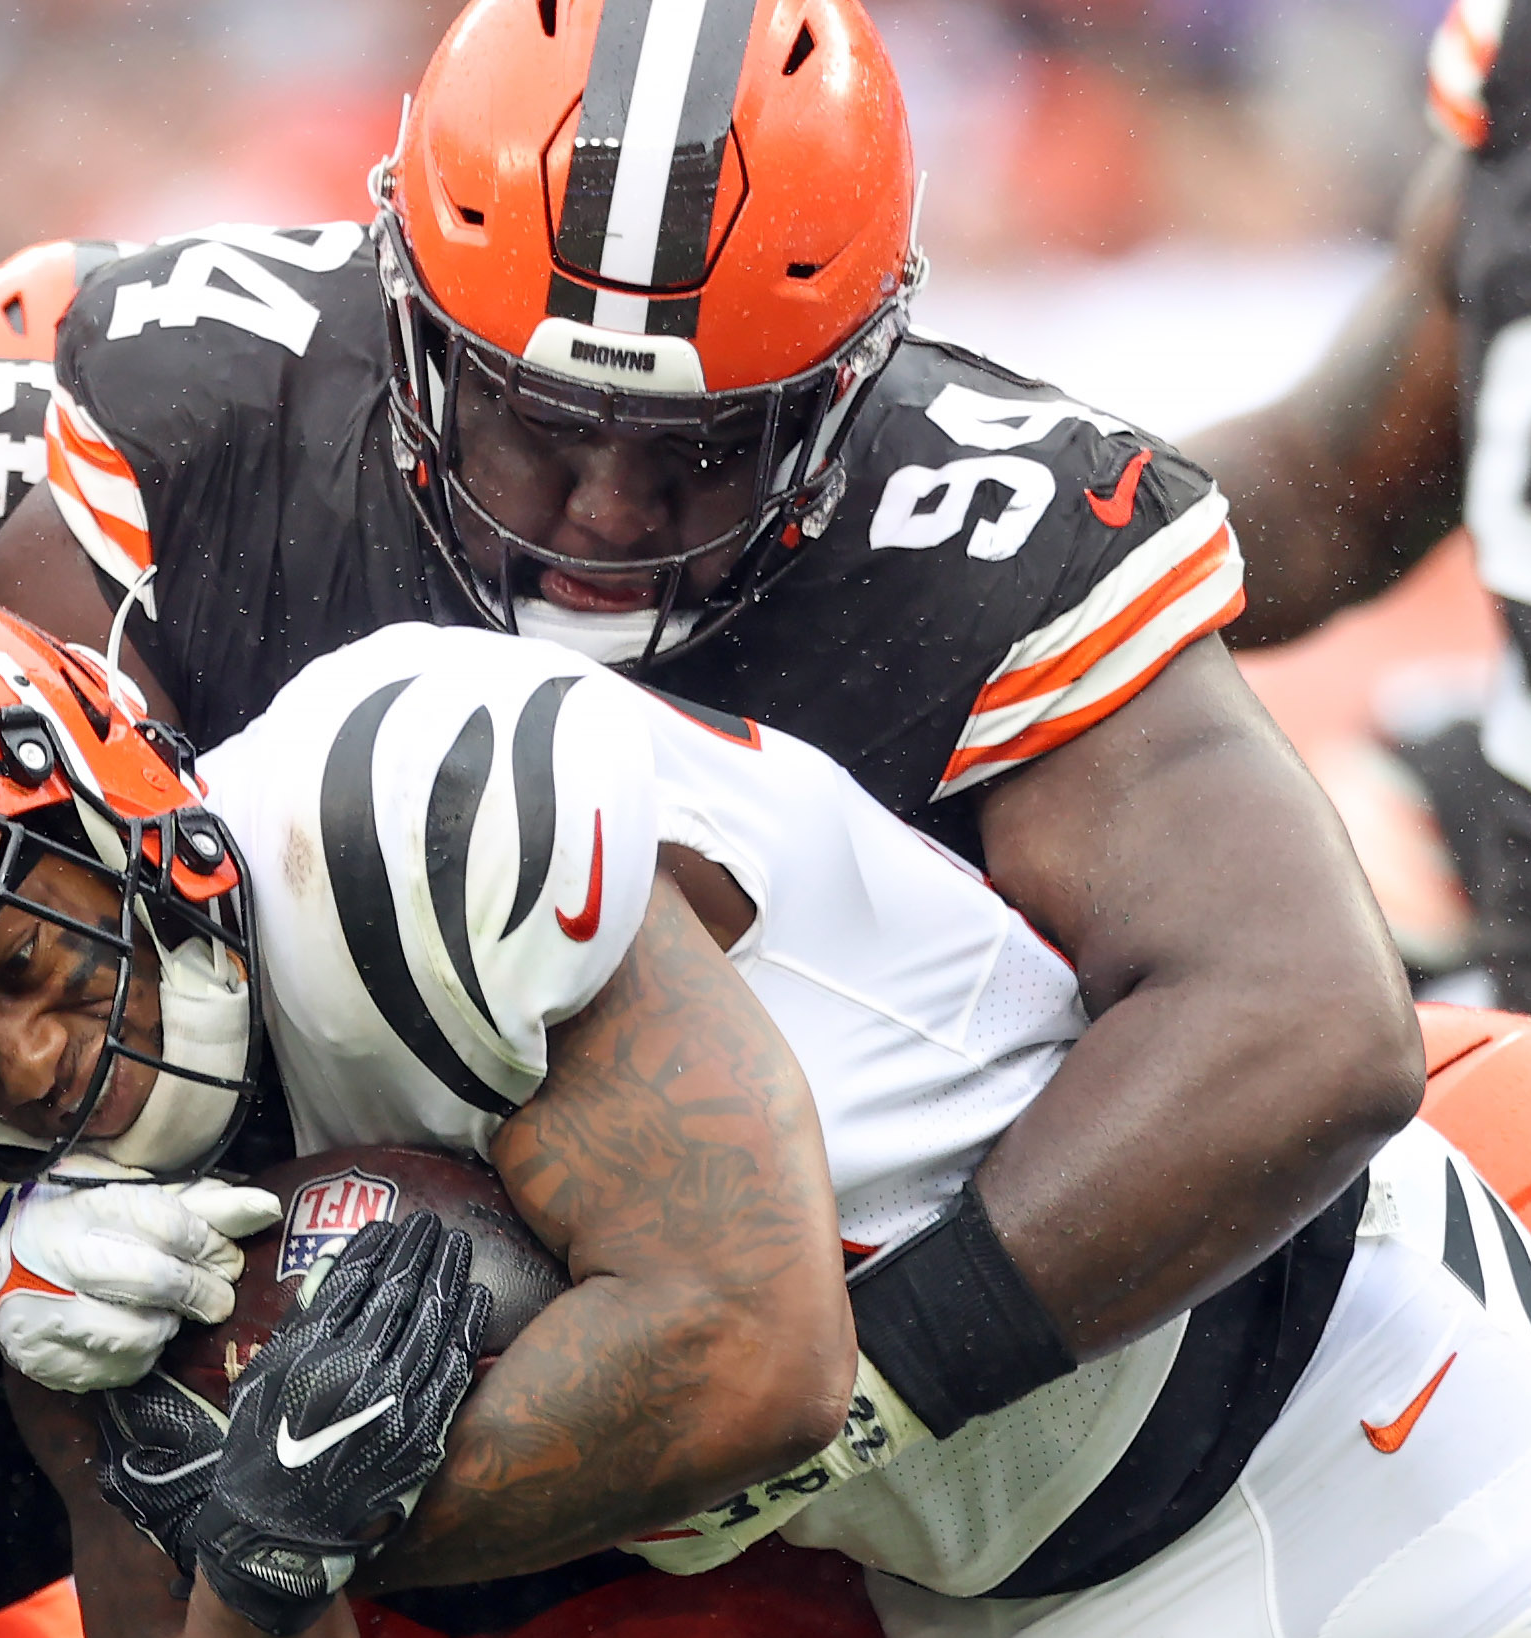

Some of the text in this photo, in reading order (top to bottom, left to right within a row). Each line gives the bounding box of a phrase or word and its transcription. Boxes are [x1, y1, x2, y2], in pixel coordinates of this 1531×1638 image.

[571, 338, 656, 373] BROWNS
[869, 382, 1136, 562] 94
[304, 1181, 385, 1230] NFL
